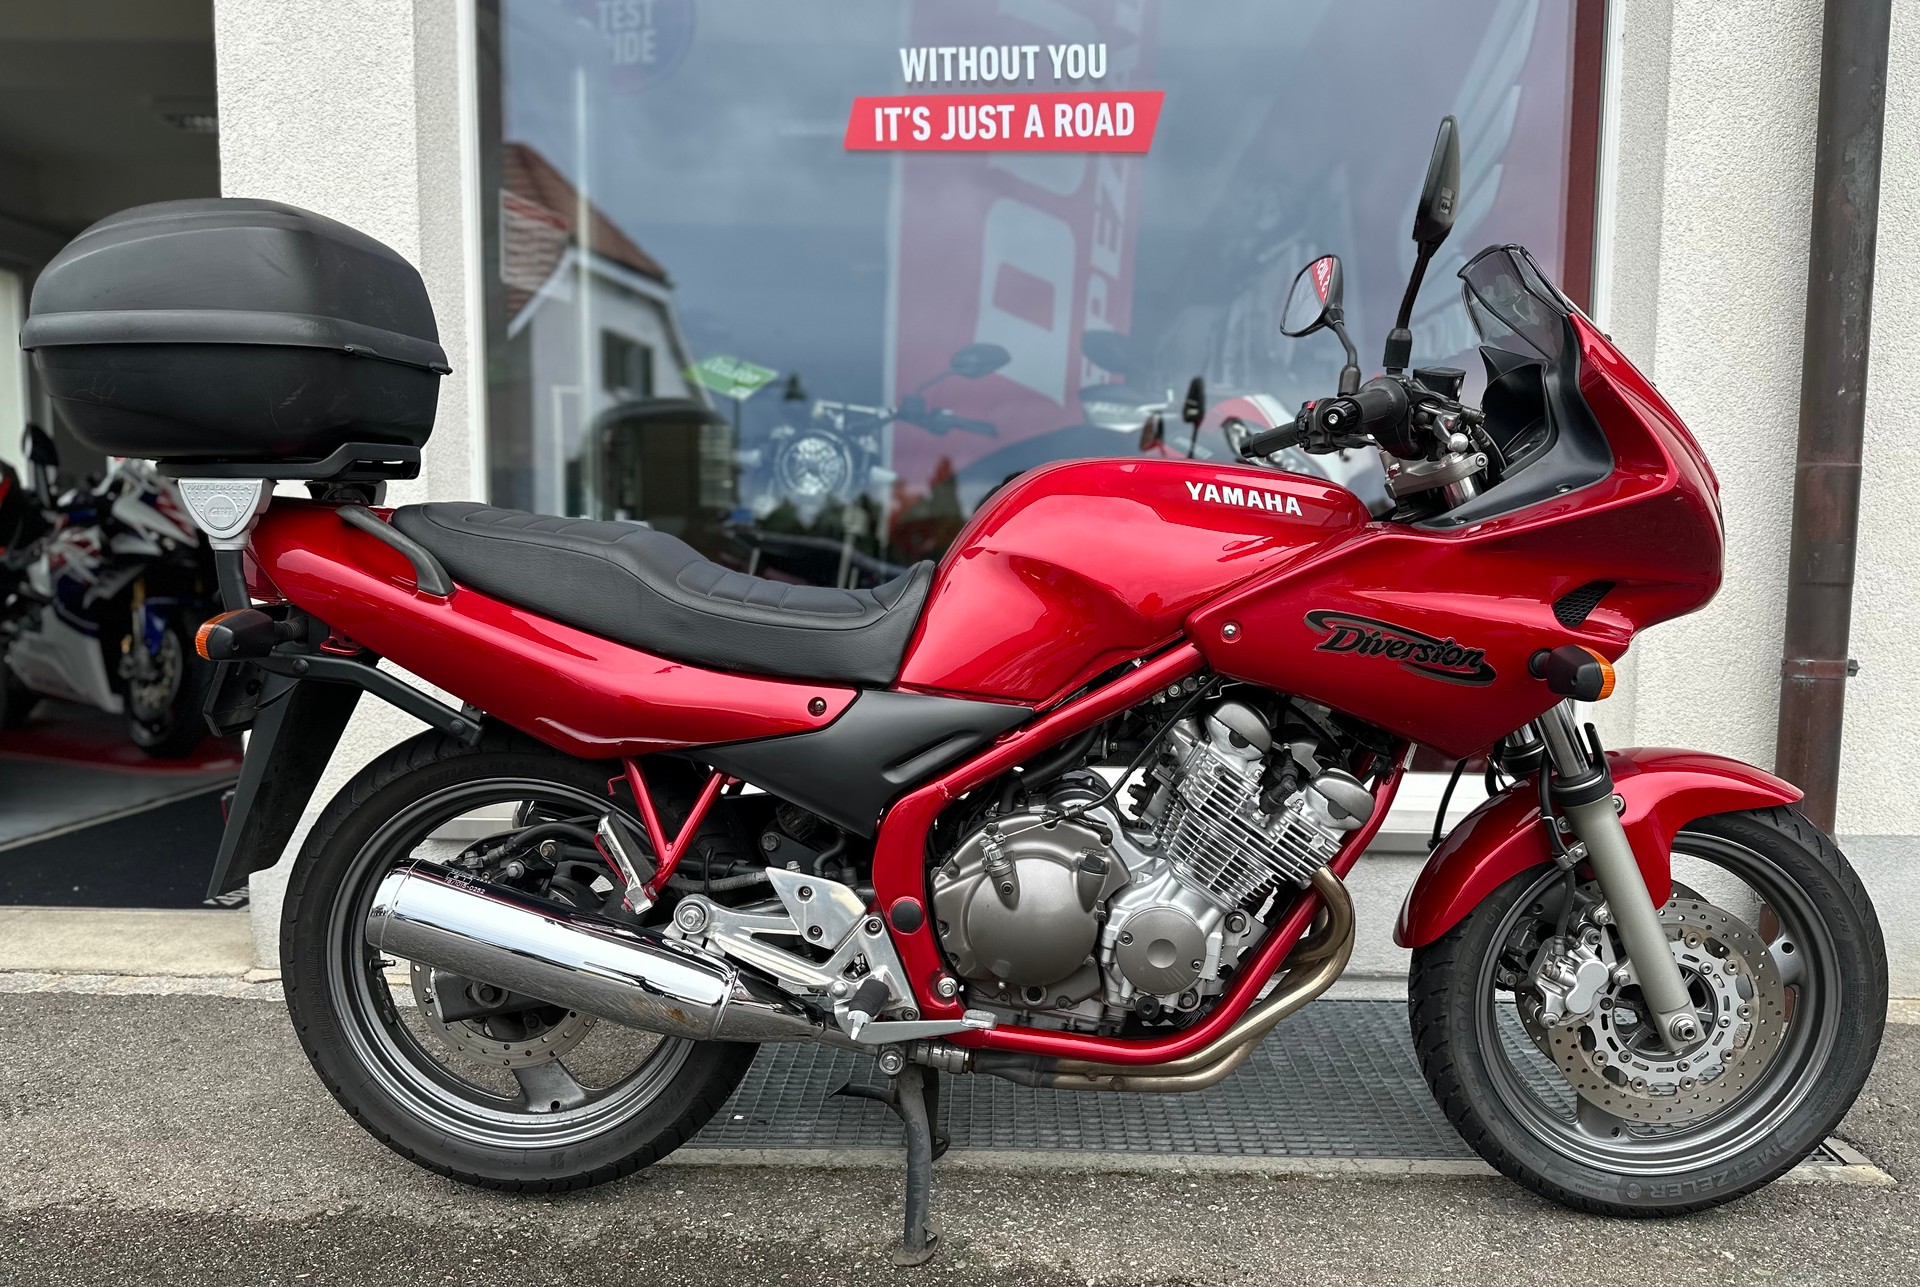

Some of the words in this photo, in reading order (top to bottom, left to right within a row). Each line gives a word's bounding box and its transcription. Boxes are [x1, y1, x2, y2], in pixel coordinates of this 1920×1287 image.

[598, 0, 654, 29] TEST
[606, 29, 657, 65] IDE
[900, 45, 1040, 82] WITHOUT
[1048, 43, 1107, 79] YOU
[874, 106, 931, 141] IT'S
[940, 104, 1015, 140] JUST
[1023, 104, 1045, 138] A
[1054, 102, 1135, 137] ROAD
[1184, 480, 1303, 517] YAMAHA
[1315, 624, 1485, 669] Diversion
[1648, 1144, 1782, 1200] METZELER
